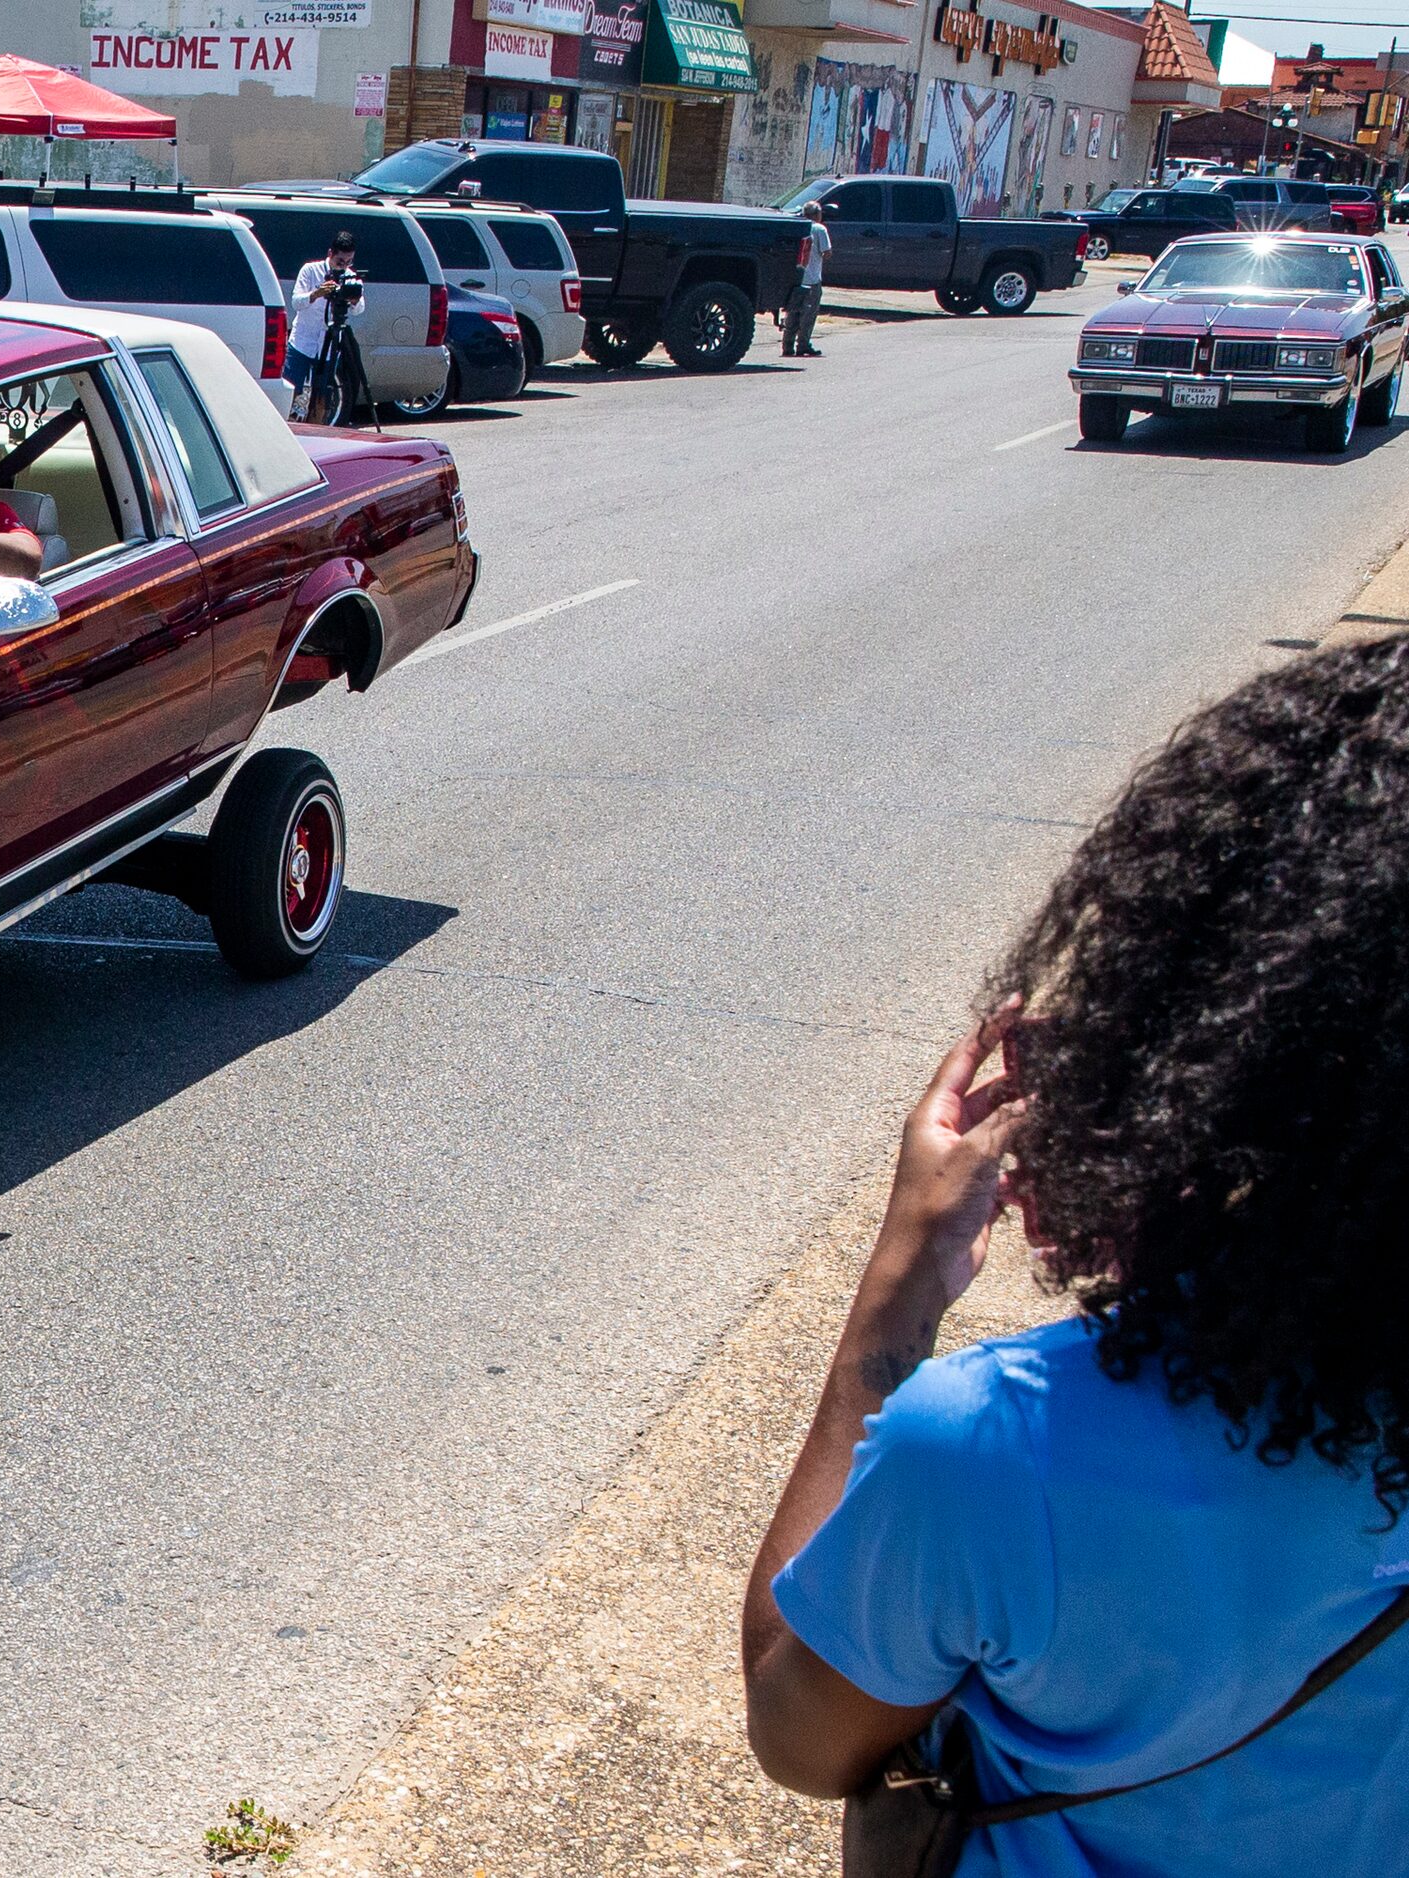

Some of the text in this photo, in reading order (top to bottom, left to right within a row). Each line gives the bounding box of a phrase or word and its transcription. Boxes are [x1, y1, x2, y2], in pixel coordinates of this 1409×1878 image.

[585, 0, 618, 38] Dream
[615, 5, 643, 42] Team
[667, 0, 735, 27] BOTANICA
[91, 35, 295, 70] INCOME TAX
[488, 31, 549, 58] INCOME TAX
[669, 24, 750, 55] SAN JUDAS TADEO
